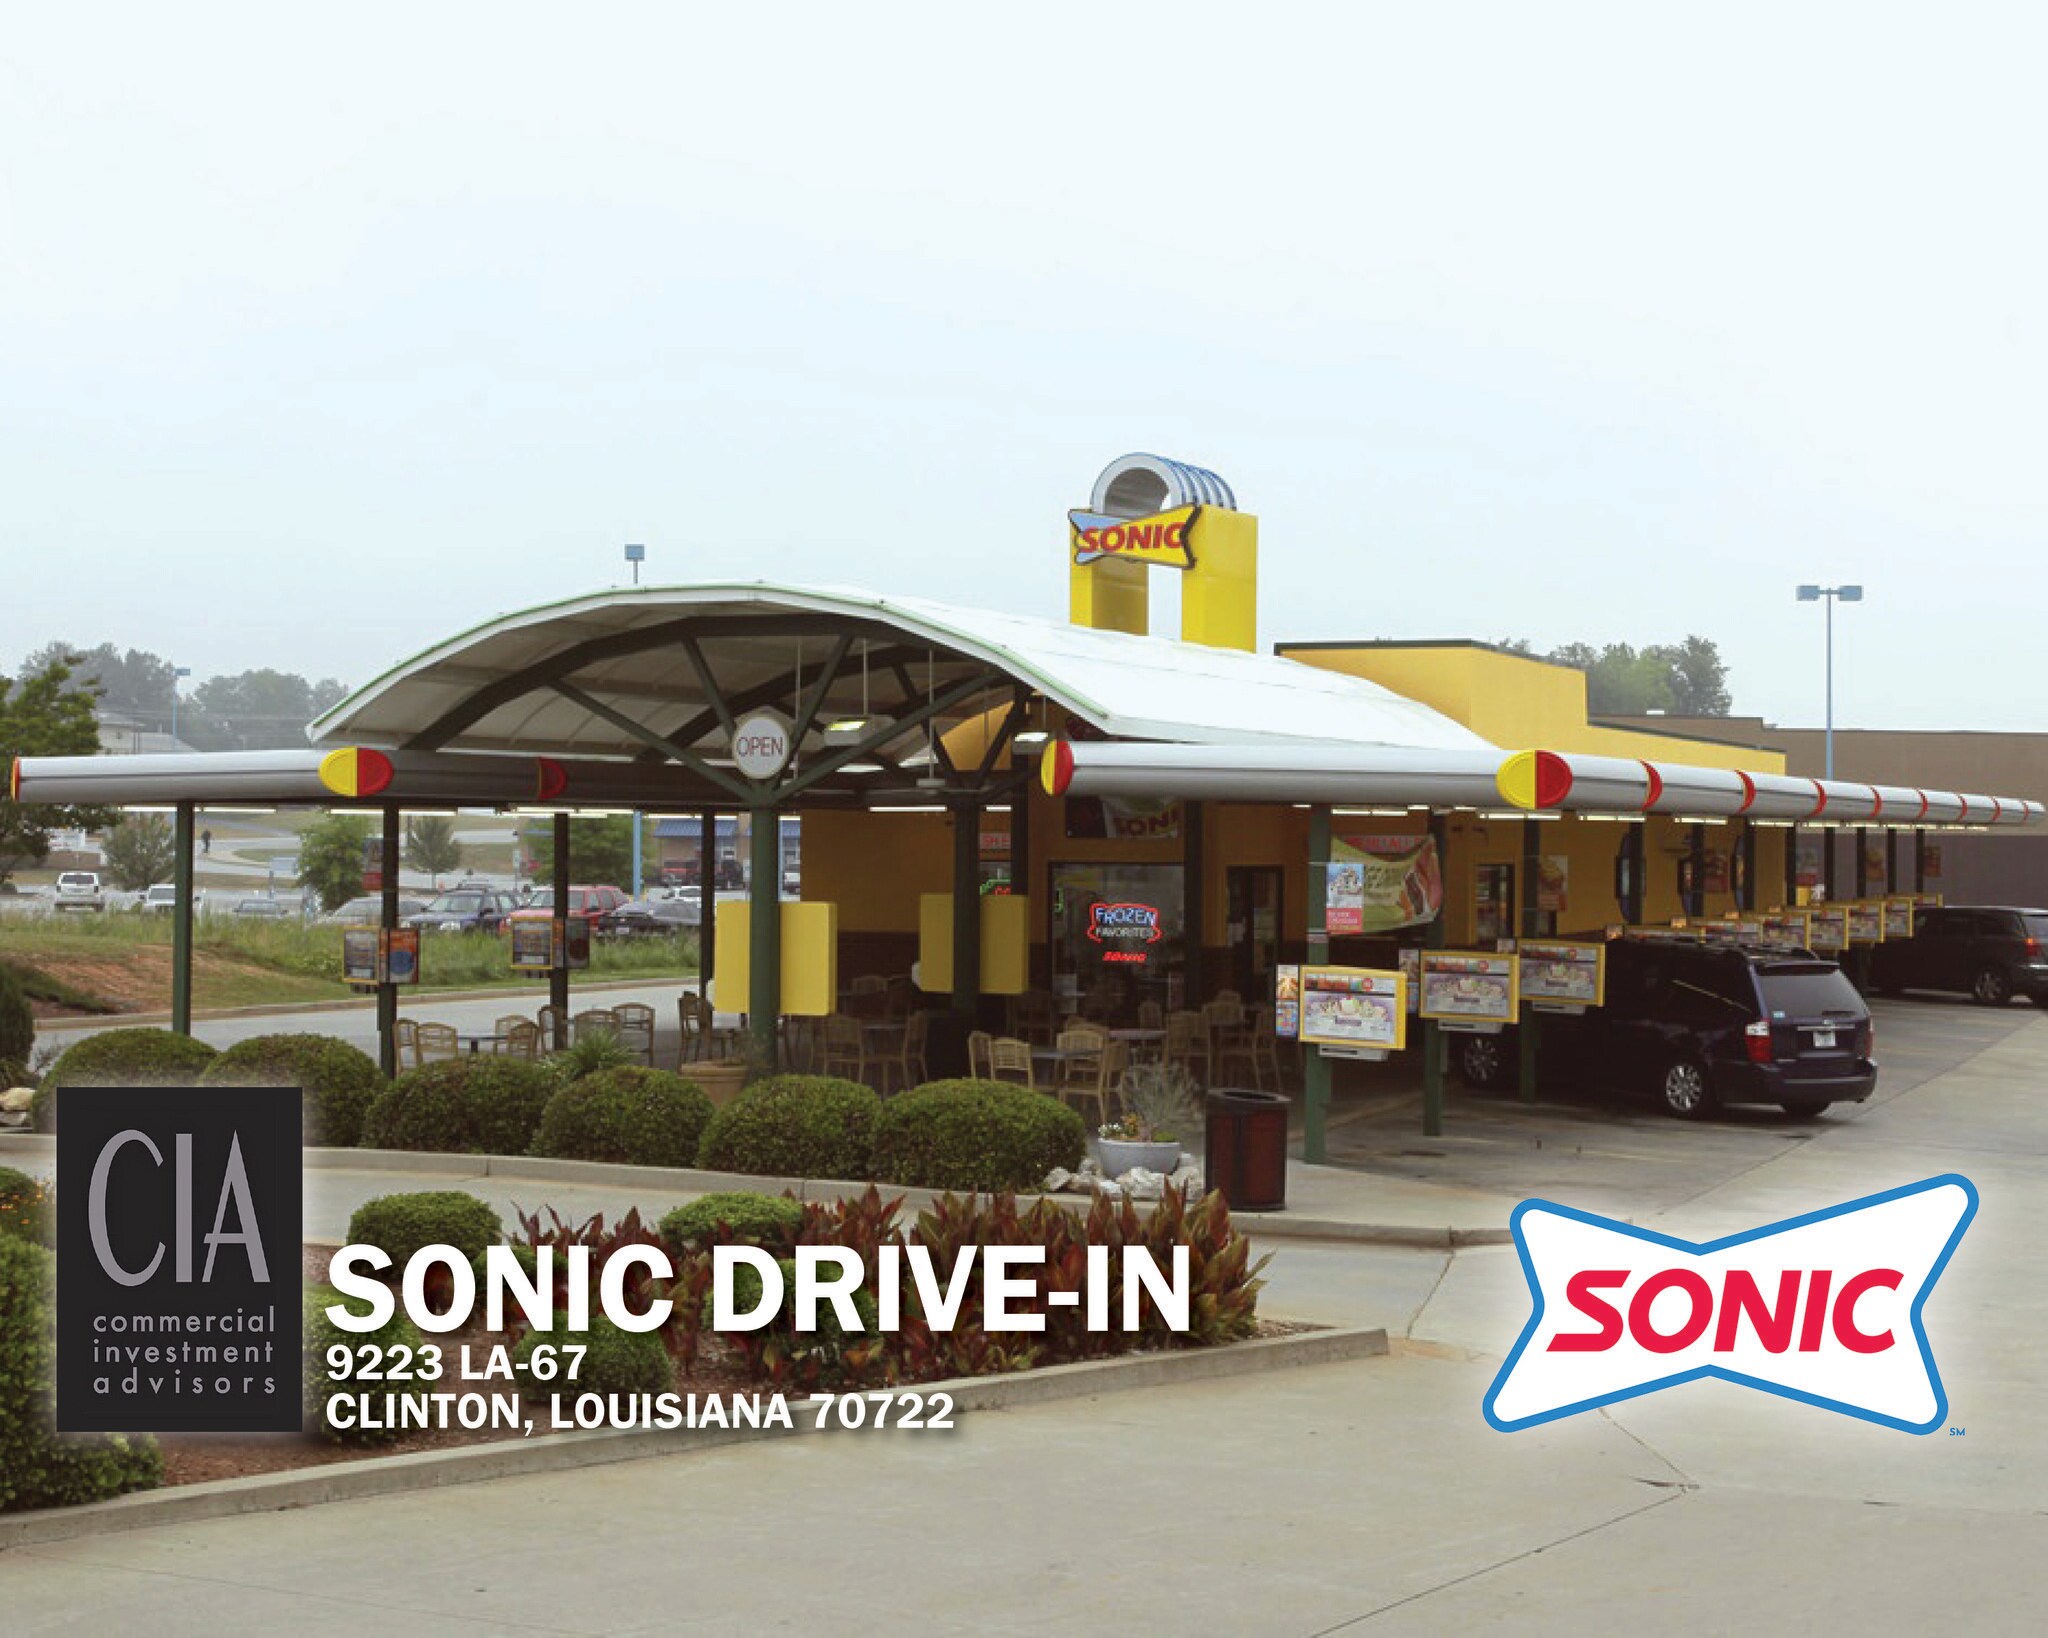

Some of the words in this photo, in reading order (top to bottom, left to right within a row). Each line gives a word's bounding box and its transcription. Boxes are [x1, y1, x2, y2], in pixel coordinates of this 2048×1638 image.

[1080, 523, 1185, 553] SONIC
[737, 736, 783, 757] OPEN
[1096, 907, 1156, 925] FROZEN
[1096, 927, 1155, 938] FAVORITES
